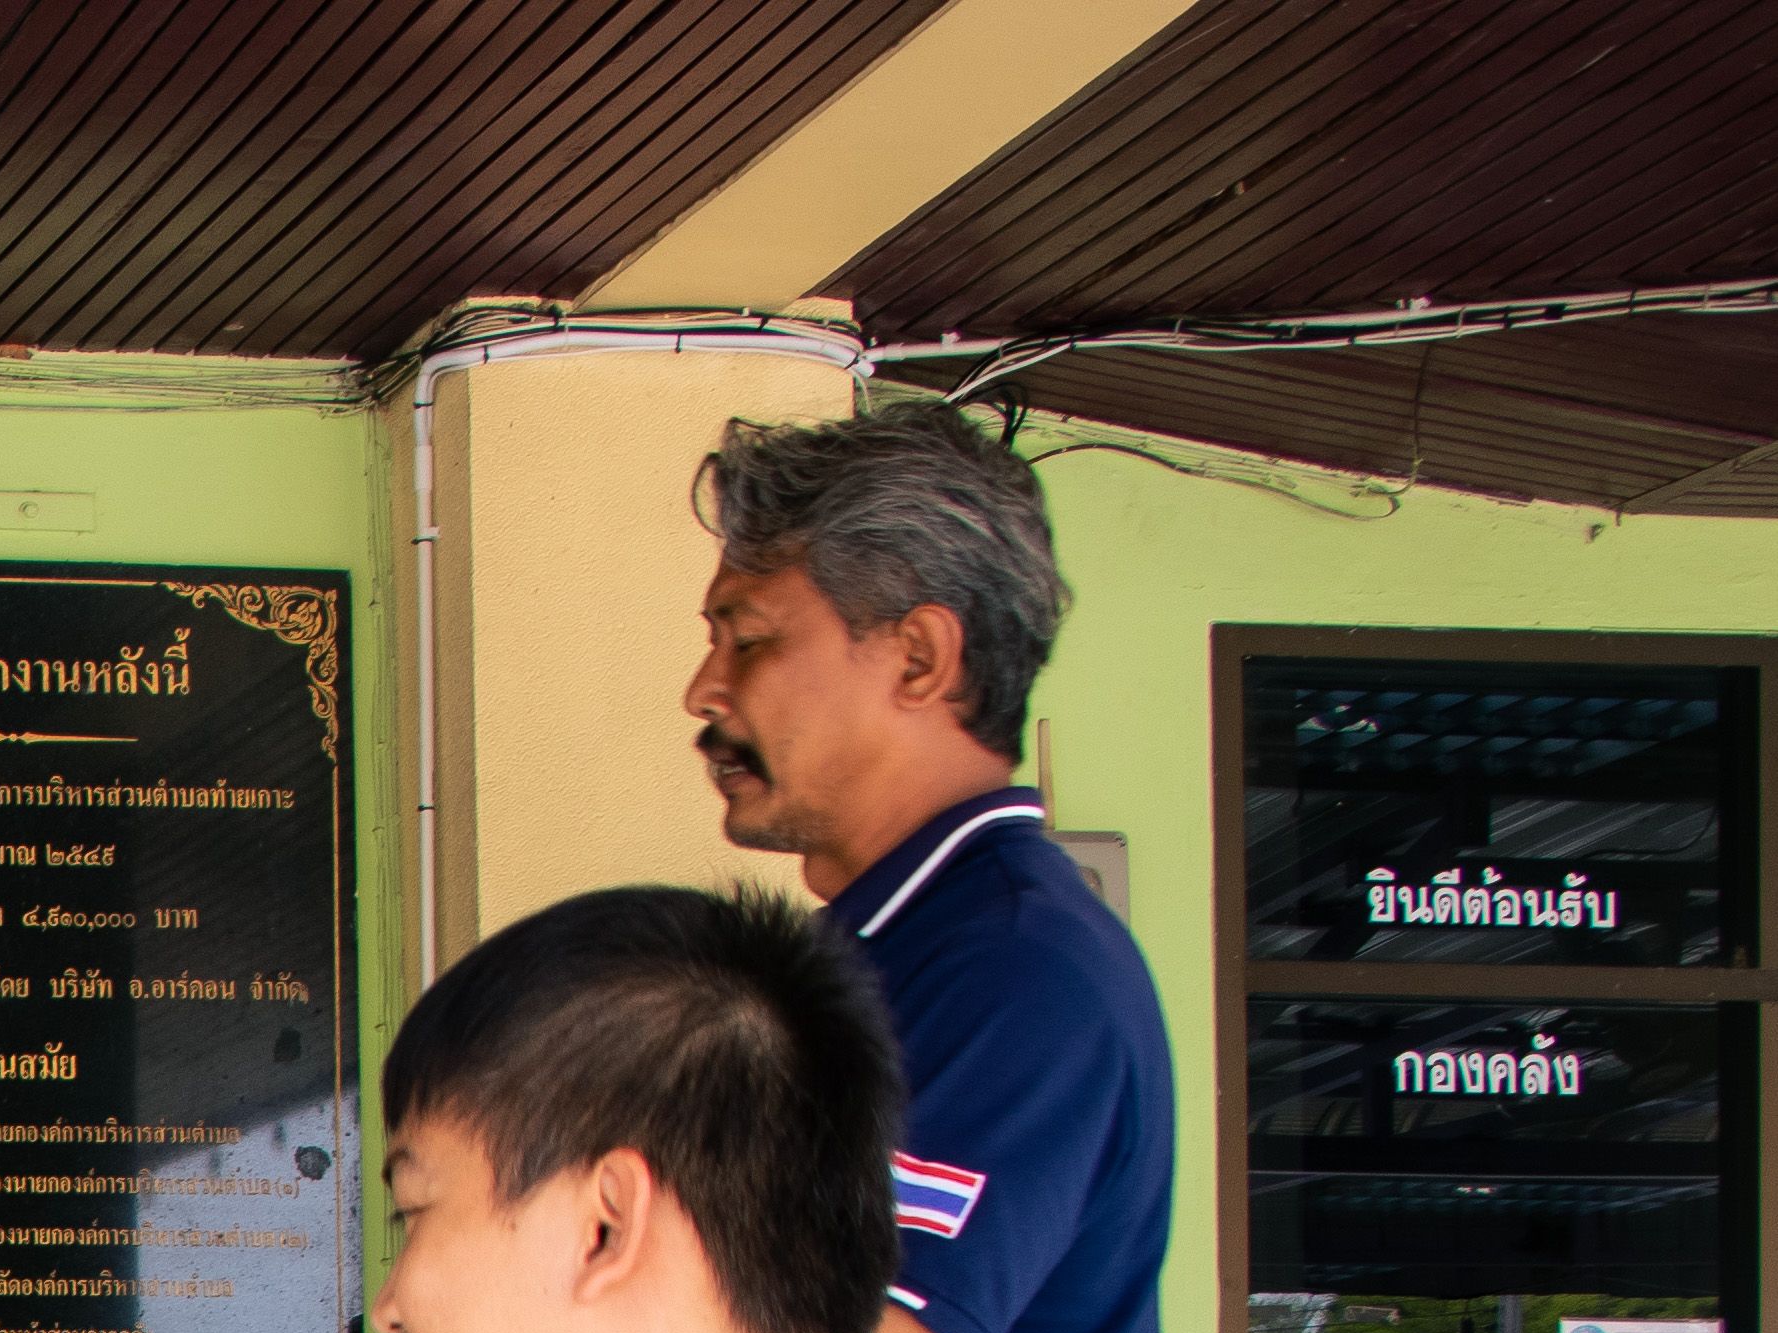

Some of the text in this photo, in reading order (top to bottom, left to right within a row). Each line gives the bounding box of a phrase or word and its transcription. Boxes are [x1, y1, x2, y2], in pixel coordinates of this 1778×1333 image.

[155, 907, 199, 929] บาท
[1367, 867, 1619, 928] ยินดีต้อนรับ
[50, 966, 115, 999] บริษัท
[1395, 1034, 1582, 1096] กองคลัง
